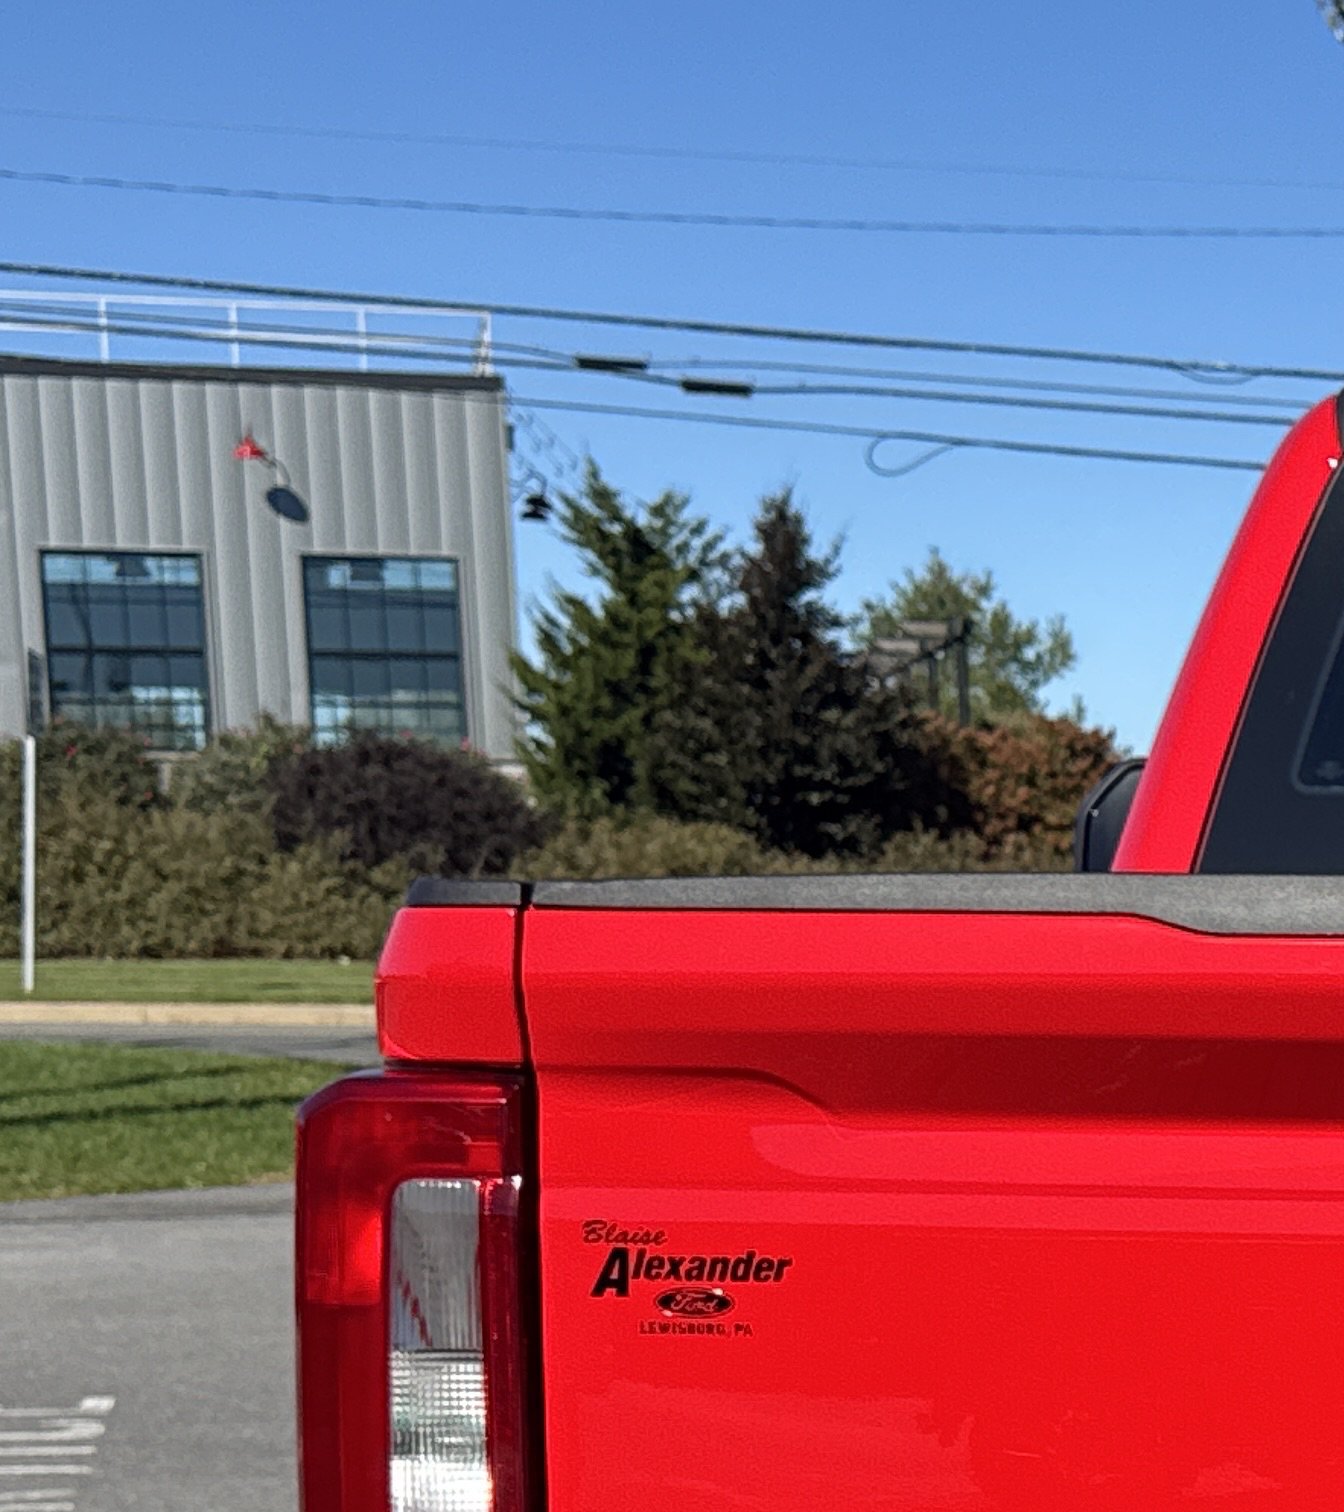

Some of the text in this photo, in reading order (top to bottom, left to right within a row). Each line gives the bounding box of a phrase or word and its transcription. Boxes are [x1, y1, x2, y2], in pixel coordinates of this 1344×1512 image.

[582, 1220, 668, 1246] Blaise
[590, 1247, 793, 1298] Alexander
[670, 1293, 719, 1313] Ford
[734, 1322, 753, 1337] PA
